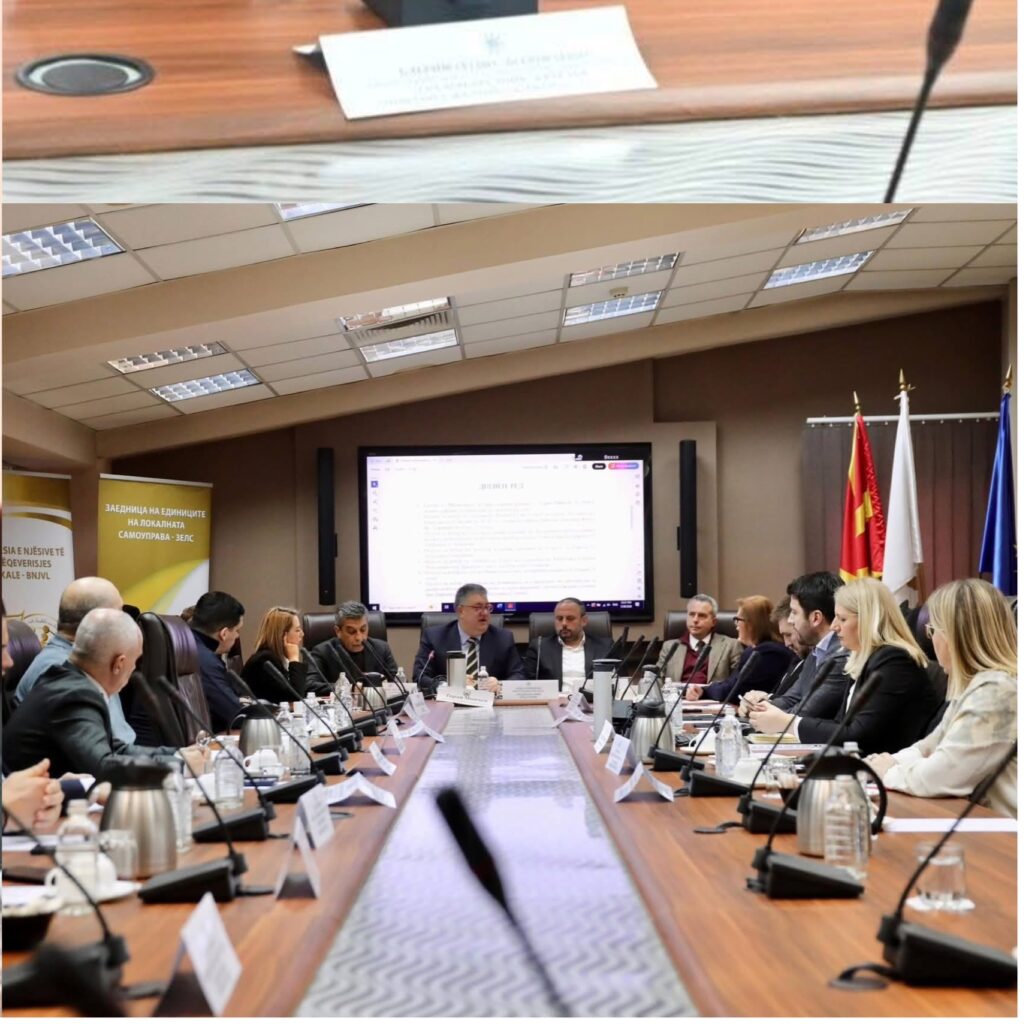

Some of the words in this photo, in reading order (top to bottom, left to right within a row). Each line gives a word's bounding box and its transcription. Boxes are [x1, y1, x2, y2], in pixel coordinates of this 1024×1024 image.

[105, 504, 147, 515] ЗАЕДНИЦА
[149, 507, 160, 515] НА
[161, 507, 206, 518] ЕДИНИЦИТЕ
[139, 519, 185, 529] ЛОКАЛНАТА
[118, 530, 170, 541] САМОУПРАВА
[176, 534, 194, 542] ЗЕЛС
[2, 546, 16, 556] SIA
[26, 571, 52, 580] BNJVL
